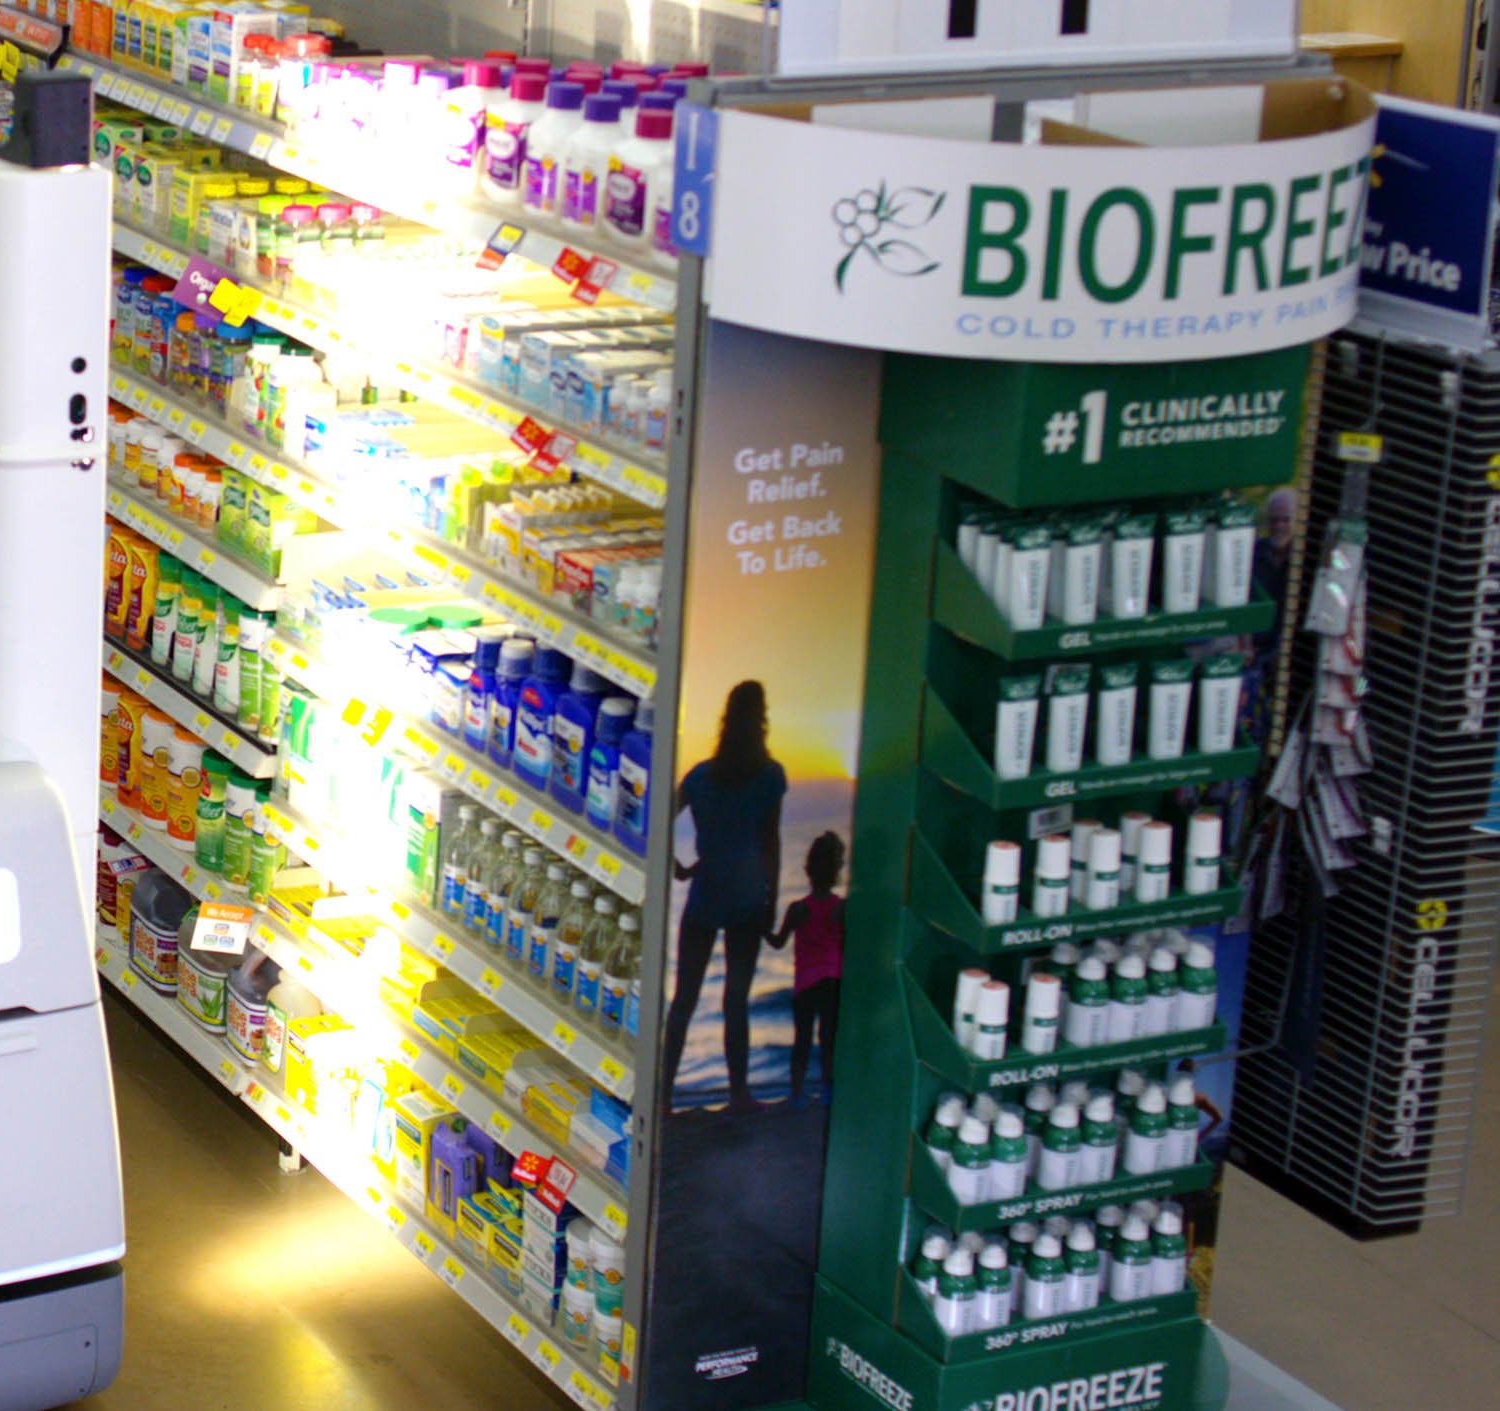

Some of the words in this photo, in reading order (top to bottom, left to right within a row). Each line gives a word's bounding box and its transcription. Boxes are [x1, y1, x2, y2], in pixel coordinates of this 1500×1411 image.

[677, 191, 699, 241] 8
[965, 155, 1371, 304] BIOFREEZ
[1386, 241, 1461, 292] Price
[956, 312, 1077, 340] COLD
[1097, 307, 1264, 340] THERAPY
[1042, 390, 1108, 465] #1
[1120, 390, 1285, 426] CLINICALLY
[1117, 417, 1280, 448] RECOMMENDED
[734, 448, 784, 474] Get
[790, 442, 845, 469] Pain
[746, 472, 827, 504] Relief.
[726, 519, 775, 546] Get
[782, 511, 842, 540] Back
[736, 551, 765, 576] To
[773, 544, 827, 572] Life.
[1059, 631, 1092, 649] GEL
[1045, 781, 1077, 797] GEL
[206, 906, 220, 916] We
[1002, 923, 1072, 946] ROLL-ON
[1389, 936, 1440, 1160] CELLUCOR
[989, 1063, 1059, 1087] ROLL-ON
[997, 1201, 1034, 1219] 360°
[1035, 1194, 1084, 1215] SPRAY
[985, 1330, 1019, 1350] 360°
[1021, 1322, 1068, 1343] SPRAY
[695, 1352, 759, 1373] PERFORMANCE
[840, 1343, 913, 1411] BIOFREEZE
